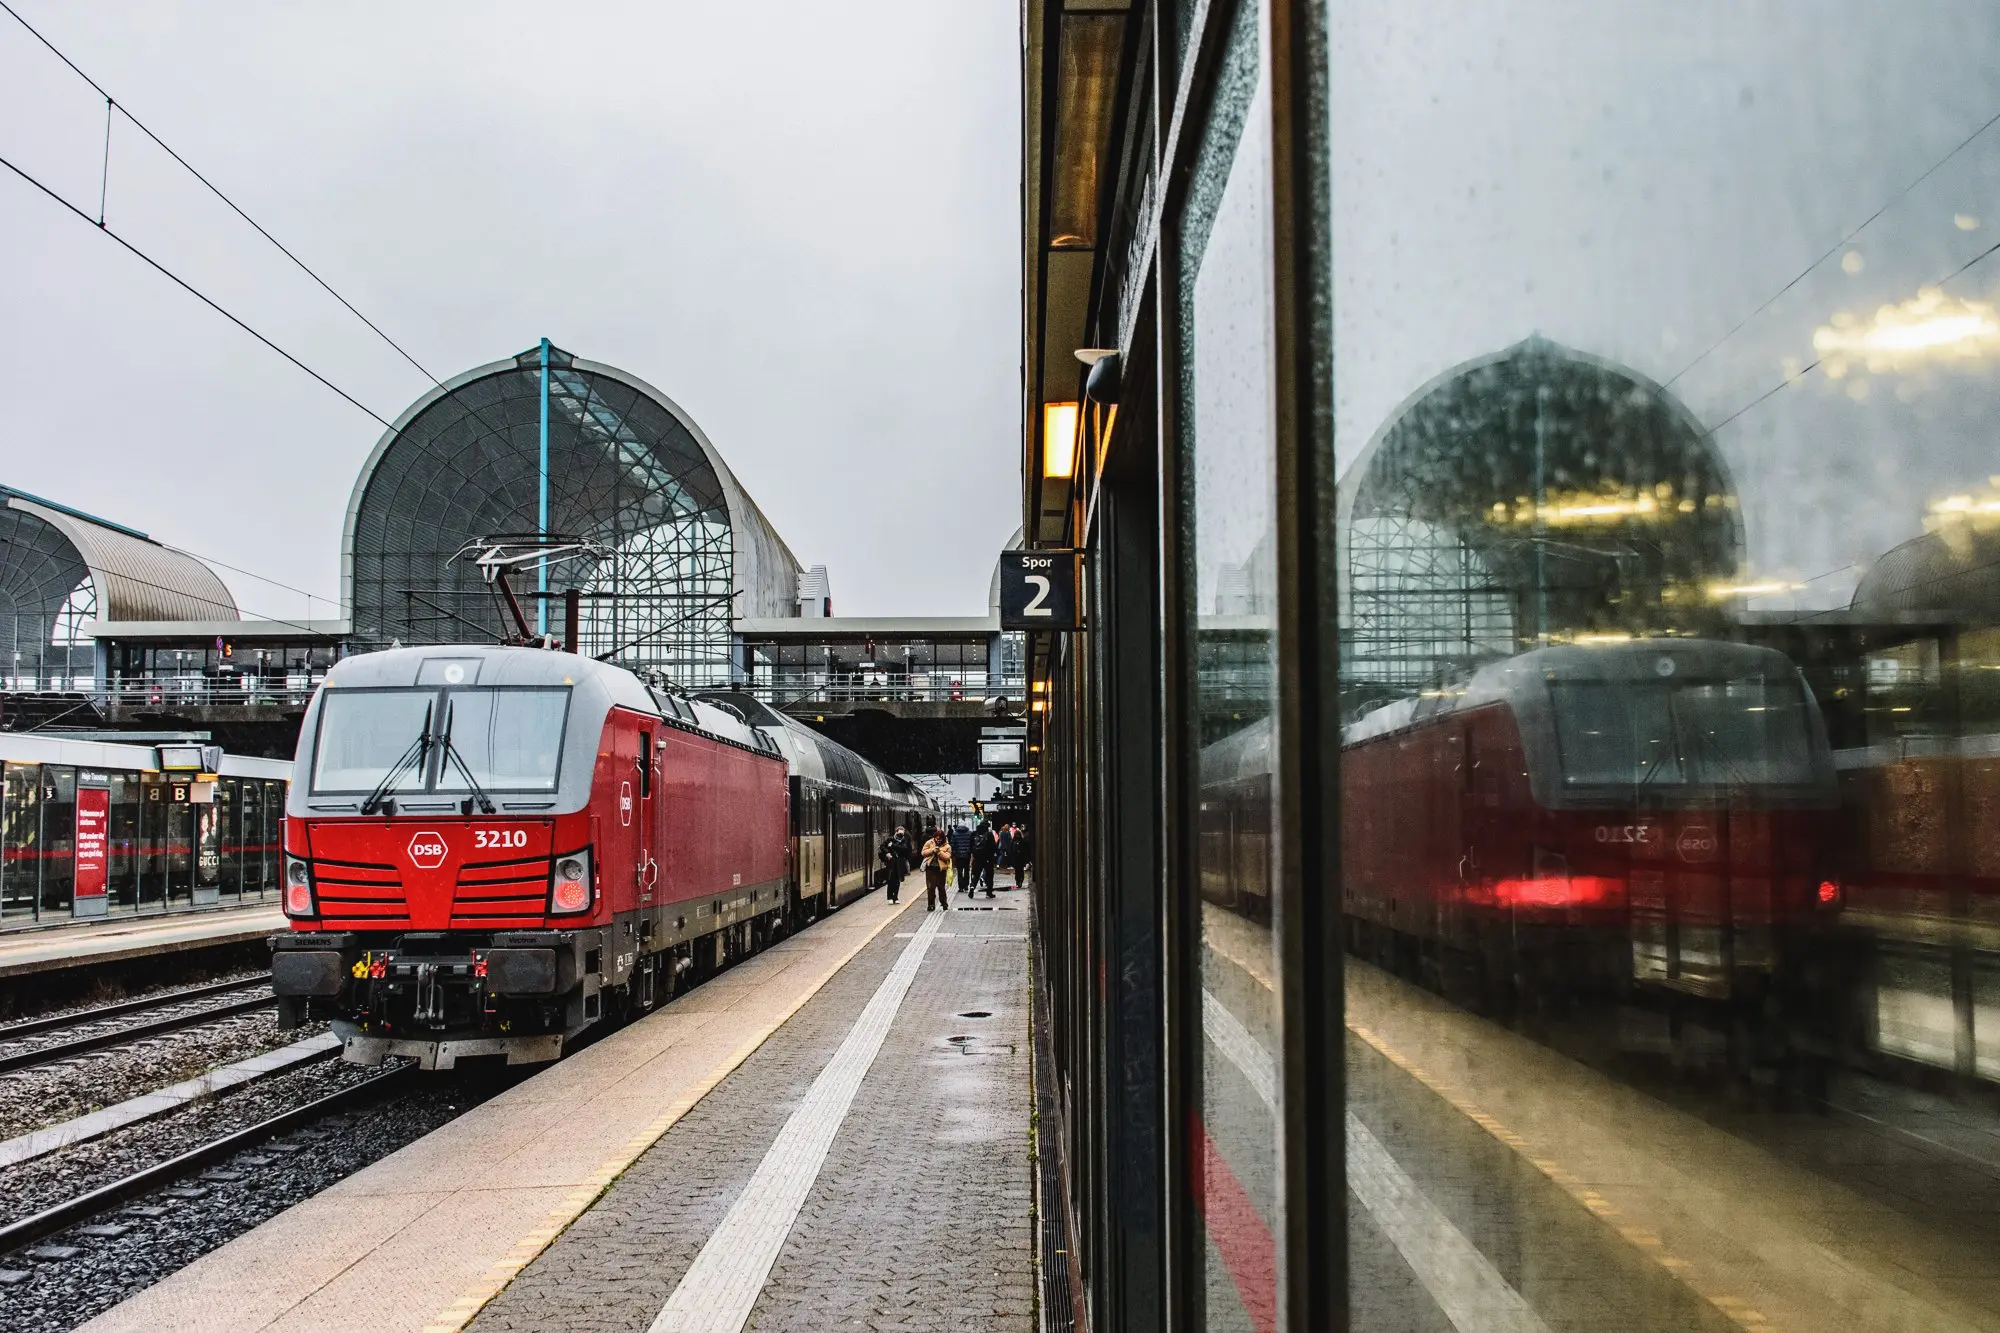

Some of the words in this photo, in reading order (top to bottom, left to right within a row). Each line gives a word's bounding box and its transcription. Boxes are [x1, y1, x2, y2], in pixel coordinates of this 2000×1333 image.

[1022, 556, 1052, 568] Spor
[1024, 575, 1052, 616] 2
[174, 788, 185, 801] B
[475, 831, 527, 848] 3210
[414, 843, 442, 856] DSB
[199, 856, 220, 867] GUCCI
[295, 938, 332, 946] SIEMENS
